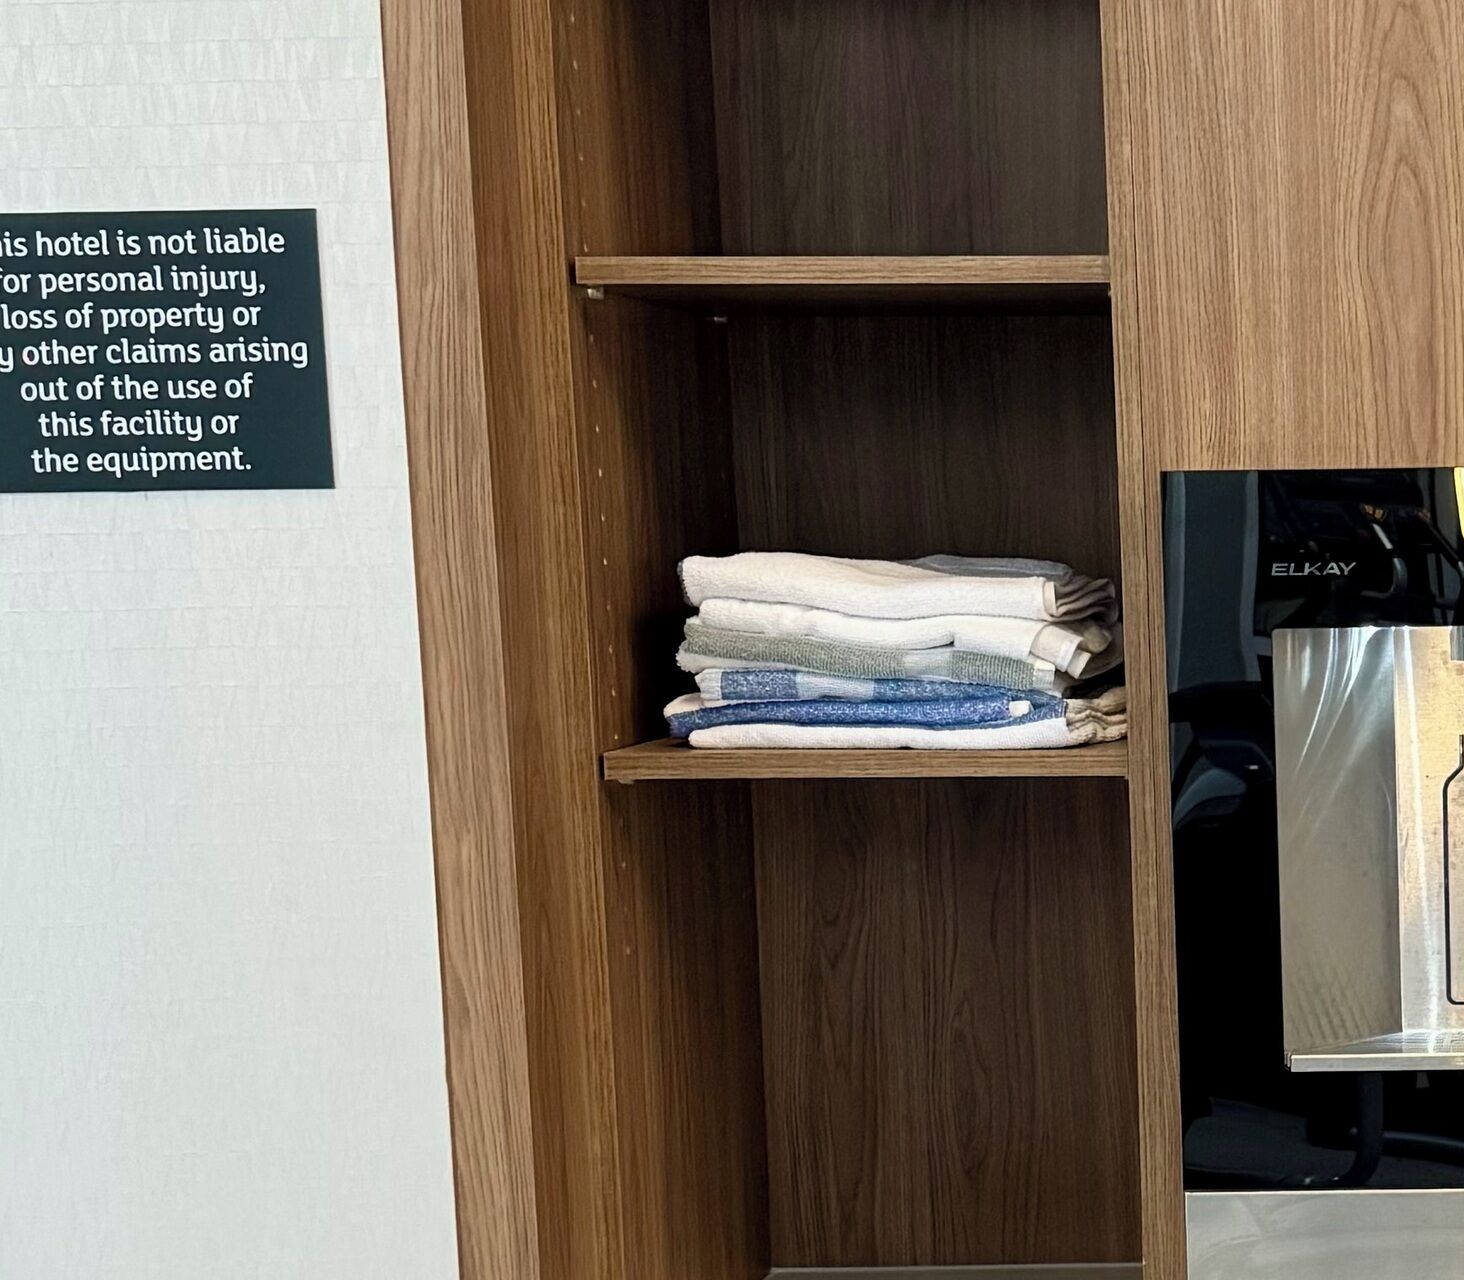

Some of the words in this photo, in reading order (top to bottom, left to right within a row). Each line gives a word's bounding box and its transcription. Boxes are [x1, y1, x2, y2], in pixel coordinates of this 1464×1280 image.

[35, 229, 110, 257] hotel
[116, 229, 142, 256] is
[147, 229, 198, 255] not
[202, 226, 286, 254] liable
[0, 267, 32, 294] or
[38, 265, 164, 300] personal
[170, 264, 267, 298] injury,
[1, 303, 58, 330] loss
[64, 301, 94, 329] of
[100, 302, 225, 335] property
[232, 306, 262, 326] or
[22, 338, 99, 366] other
[105, 337, 202, 364] claims
[209, 336, 309, 369] arising
[20, 376, 70, 402] out
[75, 374, 105, 401] of
[111, 373, 160, 400] the
[167, 378, 217, 400] use
[224, 371, 254, 399] of
[37, 411, 94, 438] this
[99, 409, 203, 442] facility
[210, 414, 240, 435] or
[30, 447, 80, 474] the
[86, 445, 253, 479] equipment.
[1271, 562, 1357, 576] ELKAY
